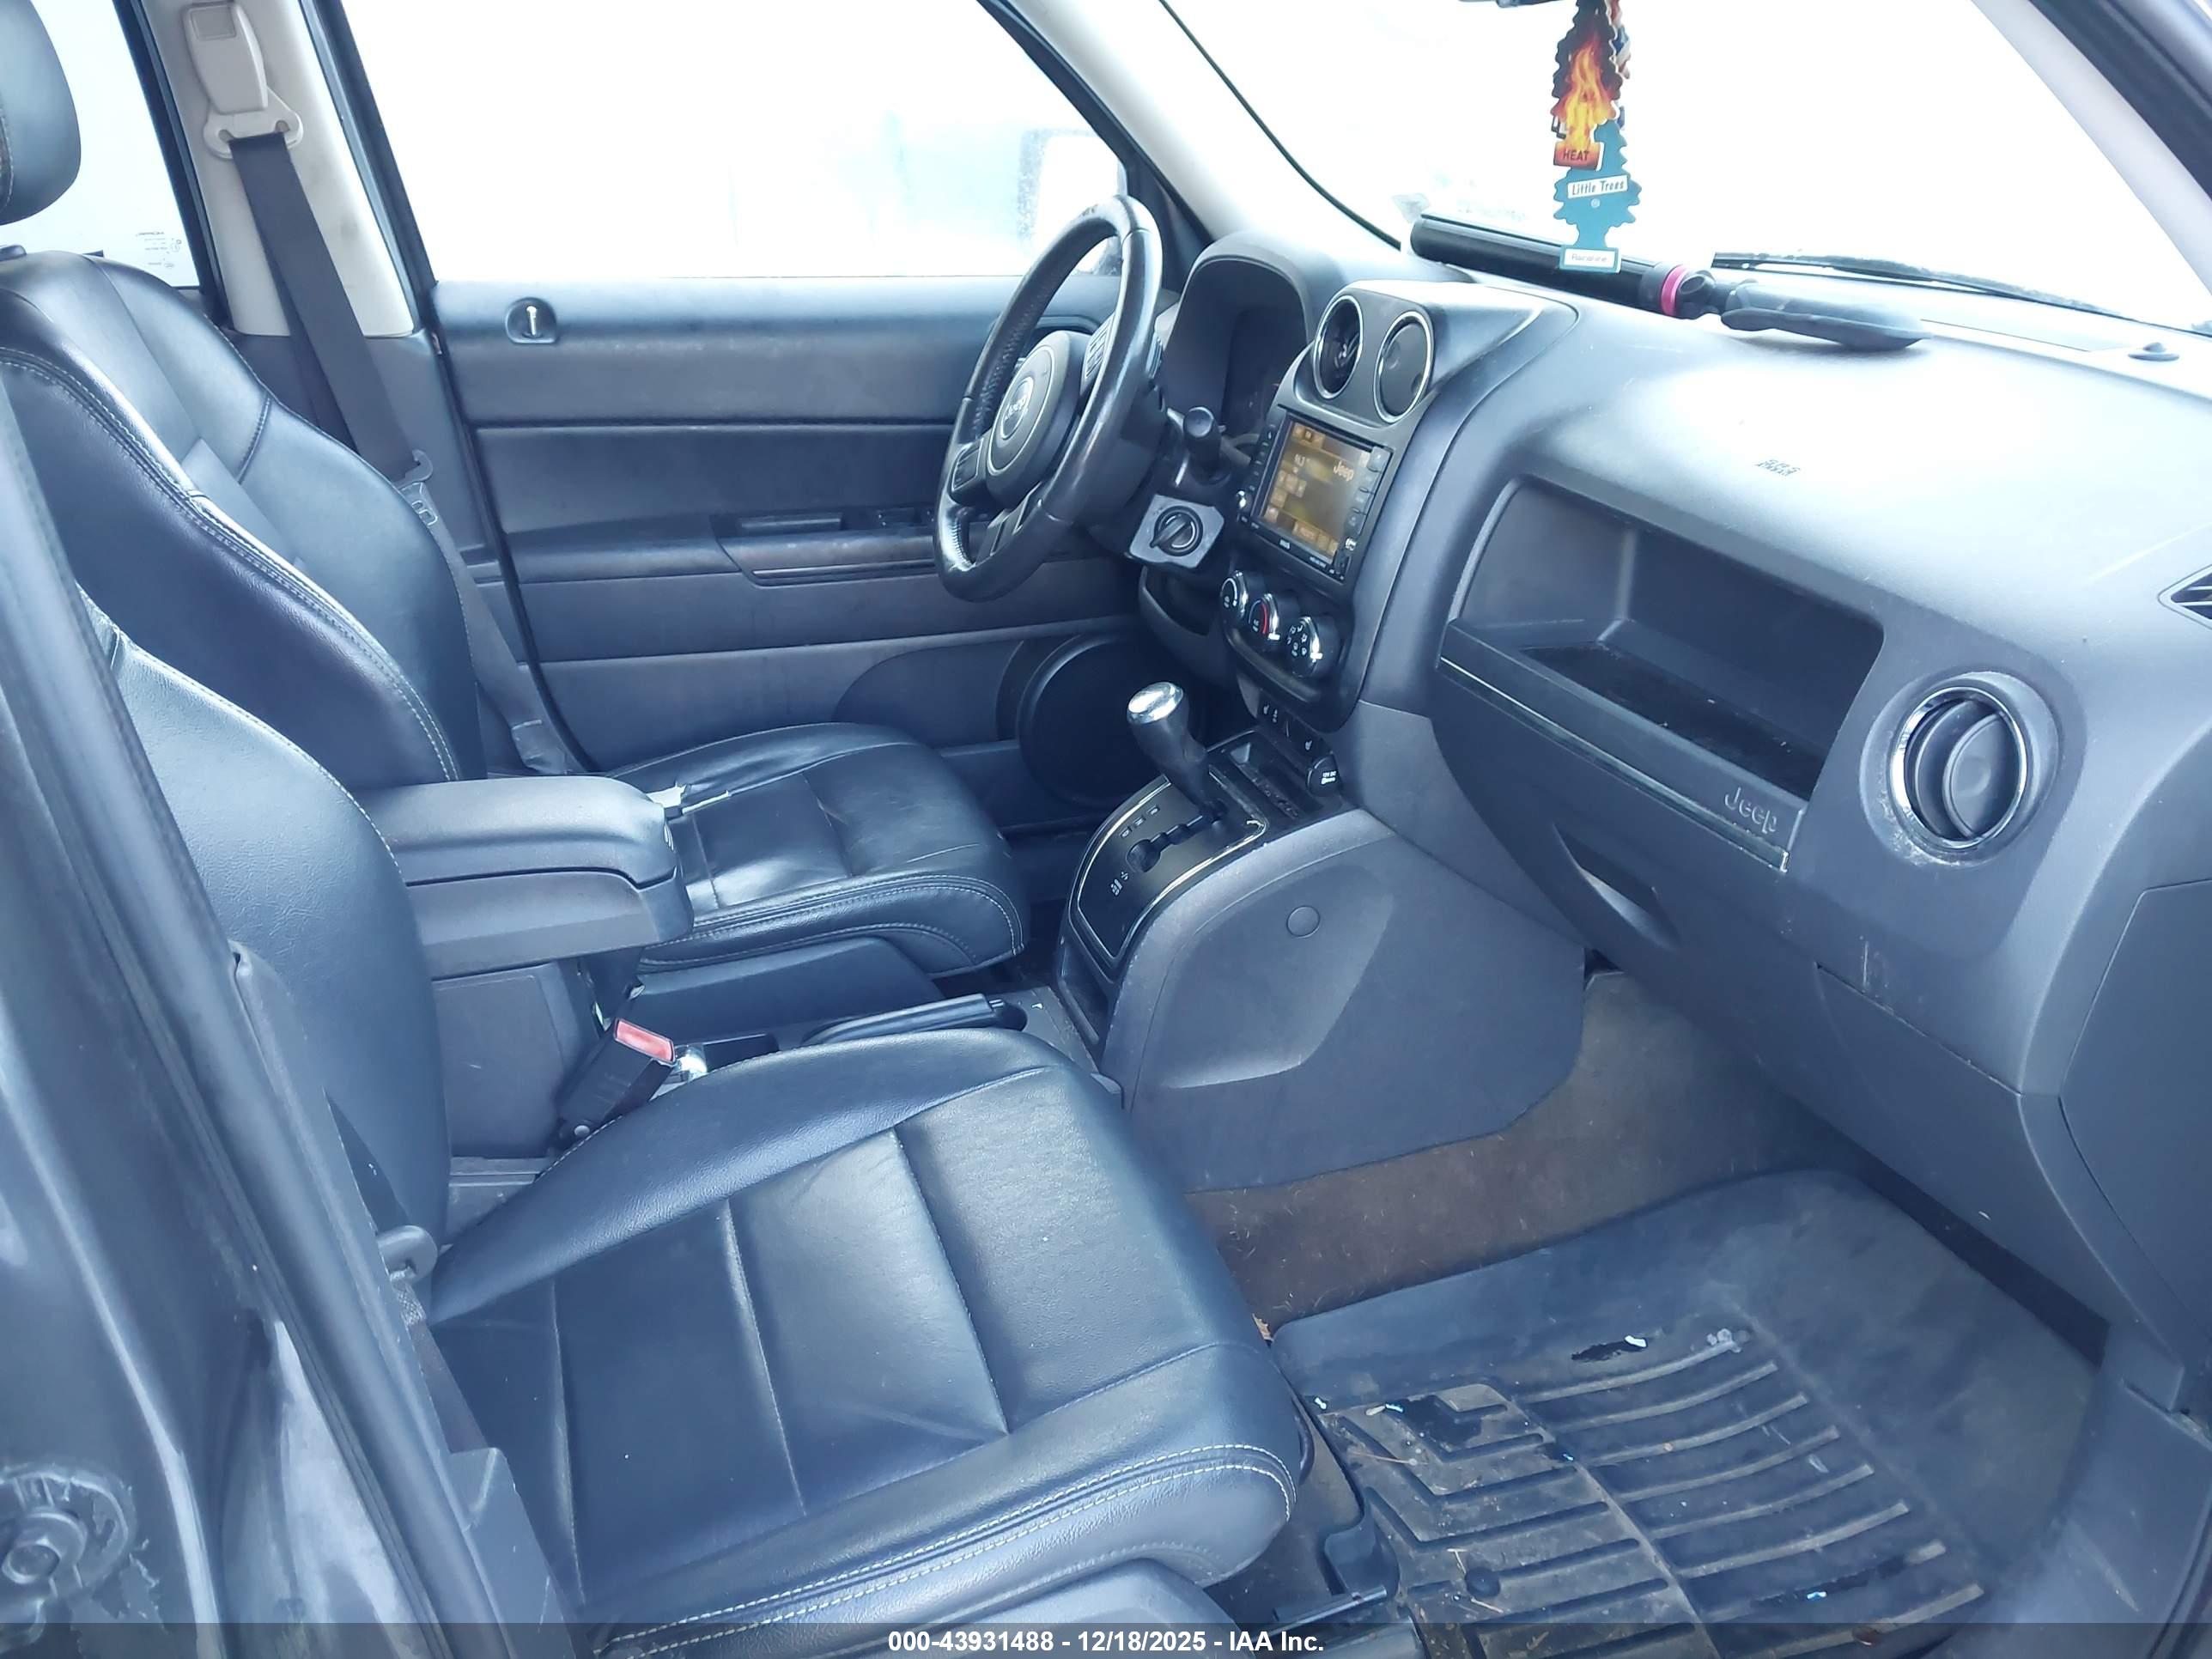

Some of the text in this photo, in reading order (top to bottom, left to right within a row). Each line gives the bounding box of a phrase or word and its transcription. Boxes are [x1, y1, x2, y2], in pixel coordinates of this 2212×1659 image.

[1563, 149, 1589, 161] HEAT
[1572, 179, 1625, 196] Little Trees
[1333, 460, 1355, 482] Jeep
[1724, 786, 1778, 835] Jeep
